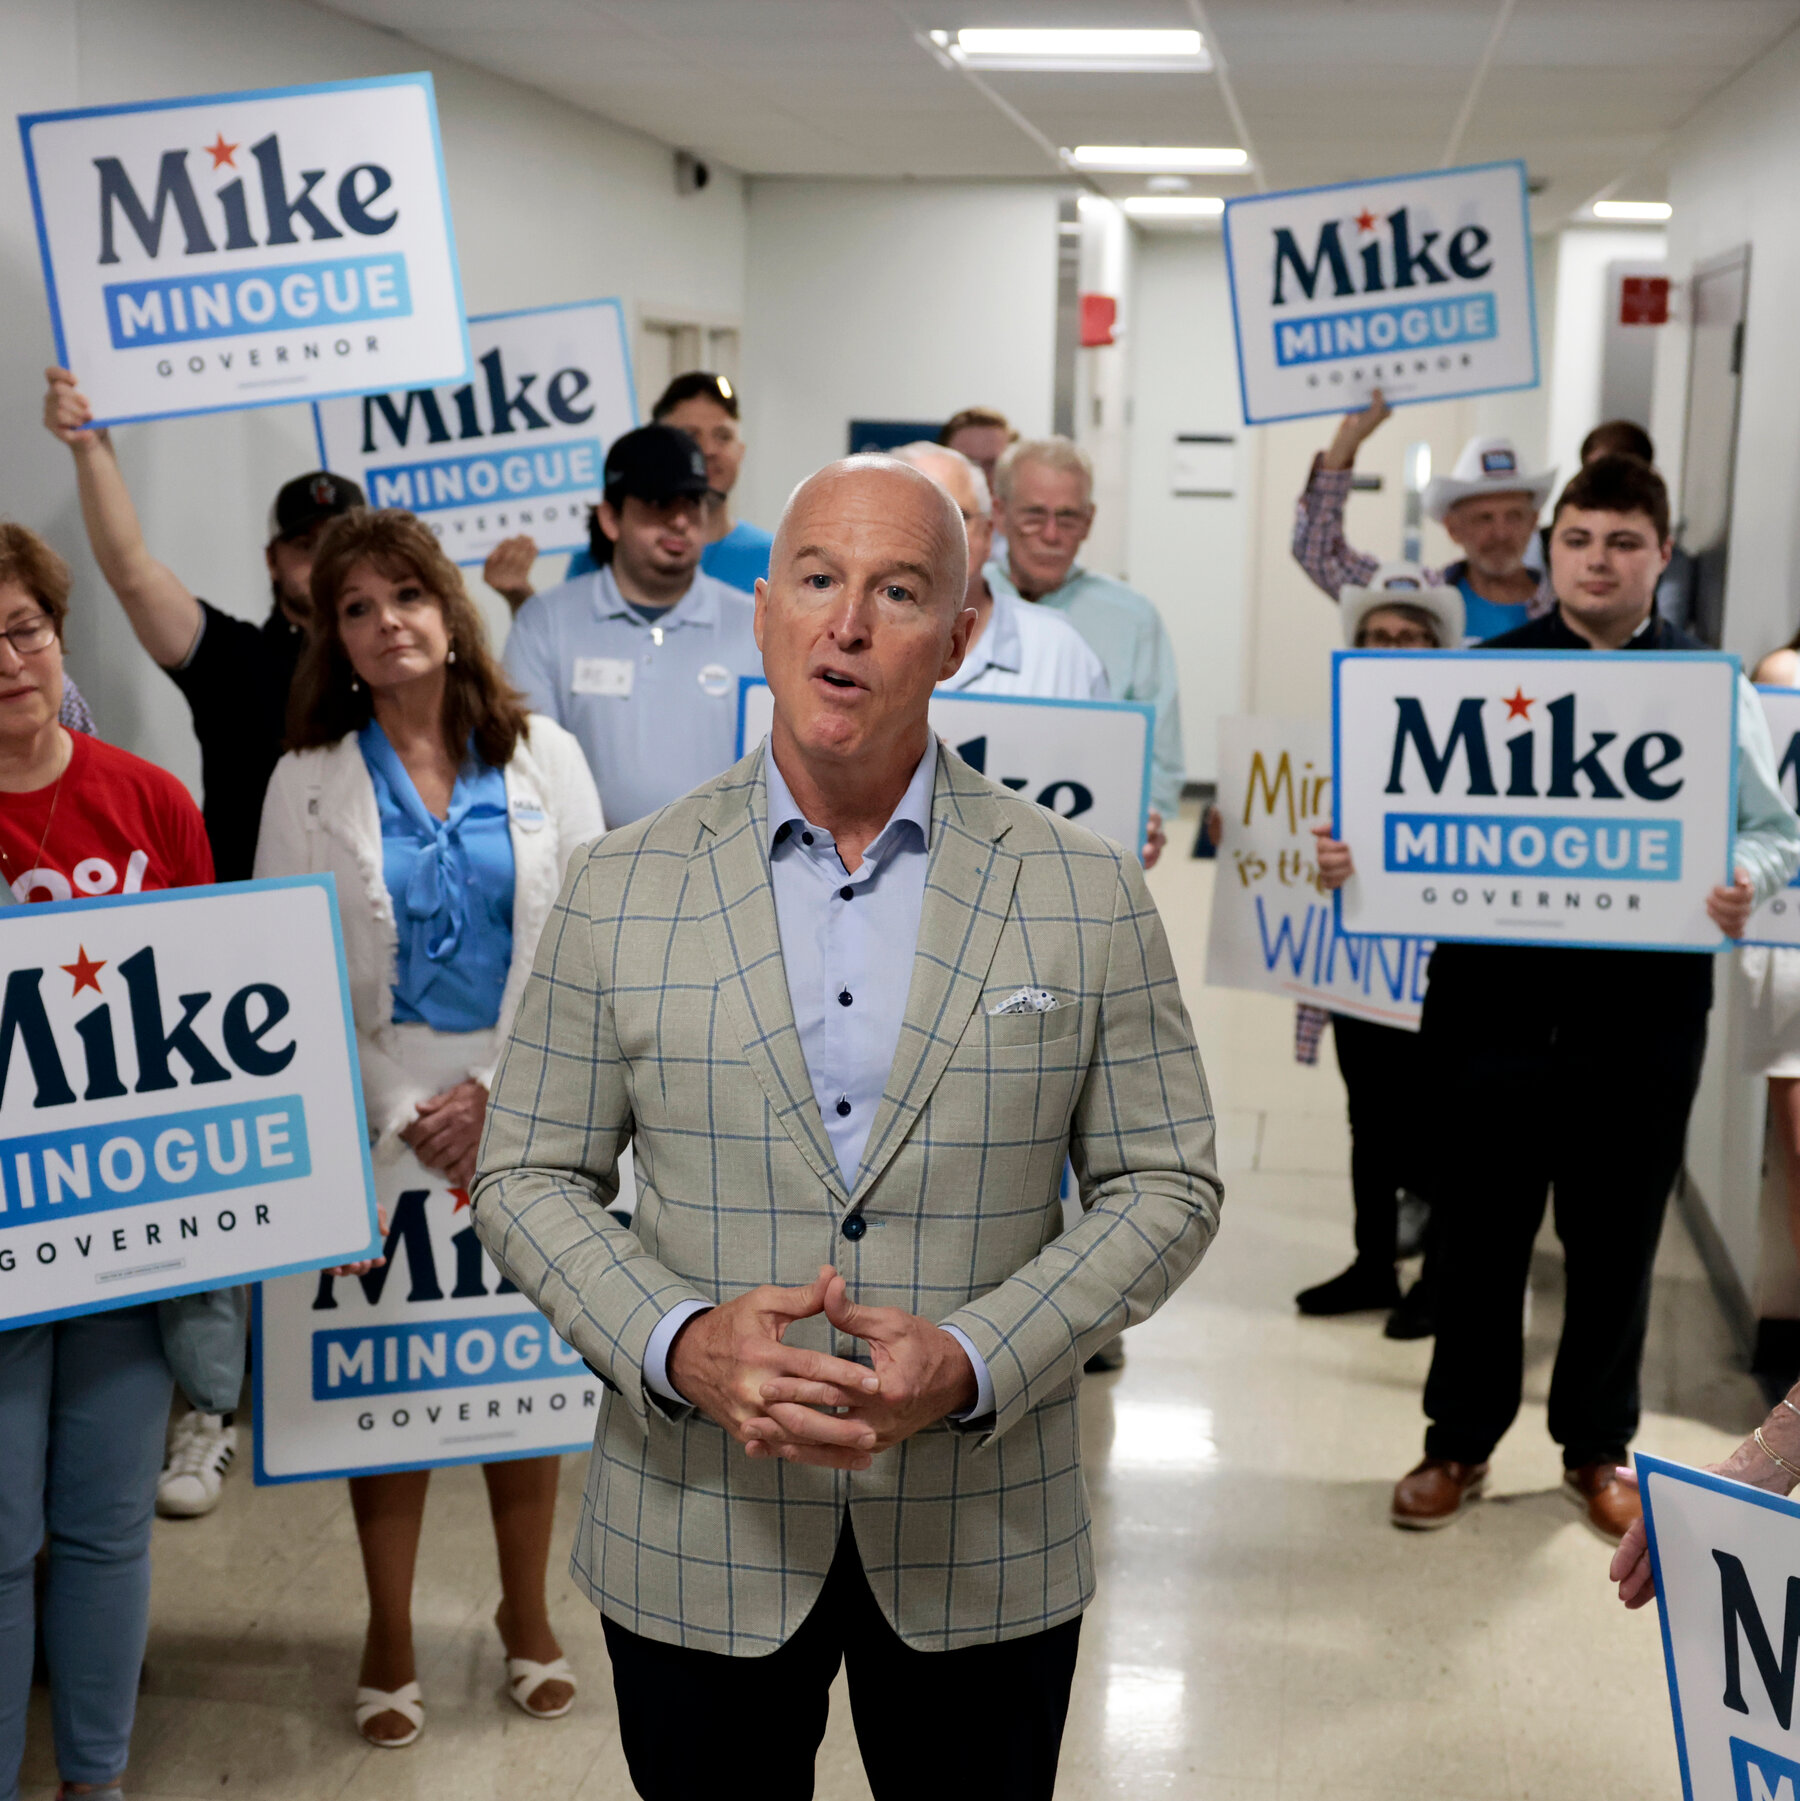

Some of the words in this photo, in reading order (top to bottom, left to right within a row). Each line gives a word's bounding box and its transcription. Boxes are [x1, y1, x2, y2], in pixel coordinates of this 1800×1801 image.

[92, 132, 399, 264] Mike
[1271, 206, 1494, 304] Mike
[118, 264, 399, 338] MINOGUE
[1280, 300, 1488, 361] MINOGUE
[157, 336, 379, 377] GOVERNOR
[1306, 352, 1472, 389] GOVERNOR
[362, 346, 597, 453] Mike
[375, 447, 595, 507] MINOGUE
[430, 503, 578, 537] OVERNOR
[1384, 693, 1685, 802] Mike
[1395, 821, 1669, 871] MINOGUE
[1421, 886, 1642, 911] GOVERNOR
[1255, 895, 1432, 1003] WINNE
[0, 1111, 294, 1213] INOGUE
[0, 1204, 271, 1273] GOVERNOR
[357, 1390, 596, 1430] GOVERNOR
